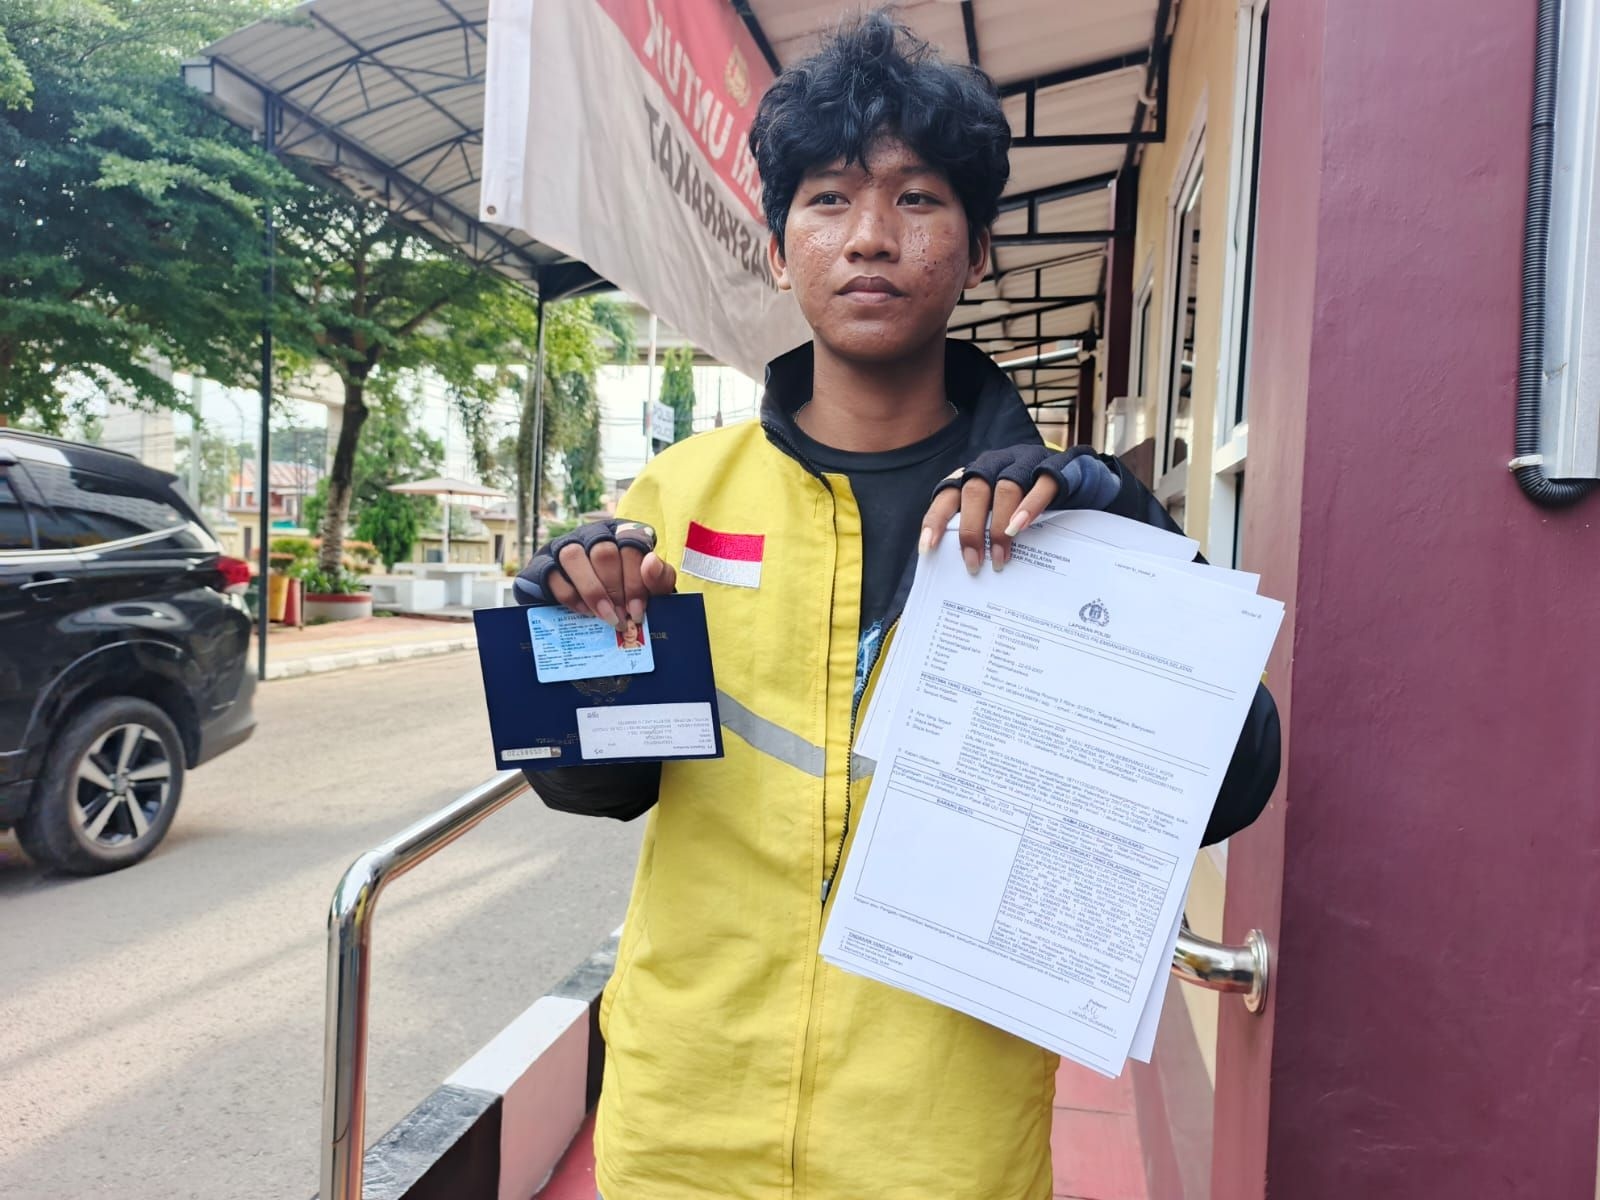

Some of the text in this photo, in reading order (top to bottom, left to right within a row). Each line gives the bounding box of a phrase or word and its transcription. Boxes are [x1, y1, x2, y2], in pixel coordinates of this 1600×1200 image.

[1024, 556, 1056, 570] PALEMBANG
[1044, 550, 1070, 563] INDONESIA
[956, 605, 991, 619] MELAPORKAN
[1068, 621, 1111, 638] LAPORAN POLISI
